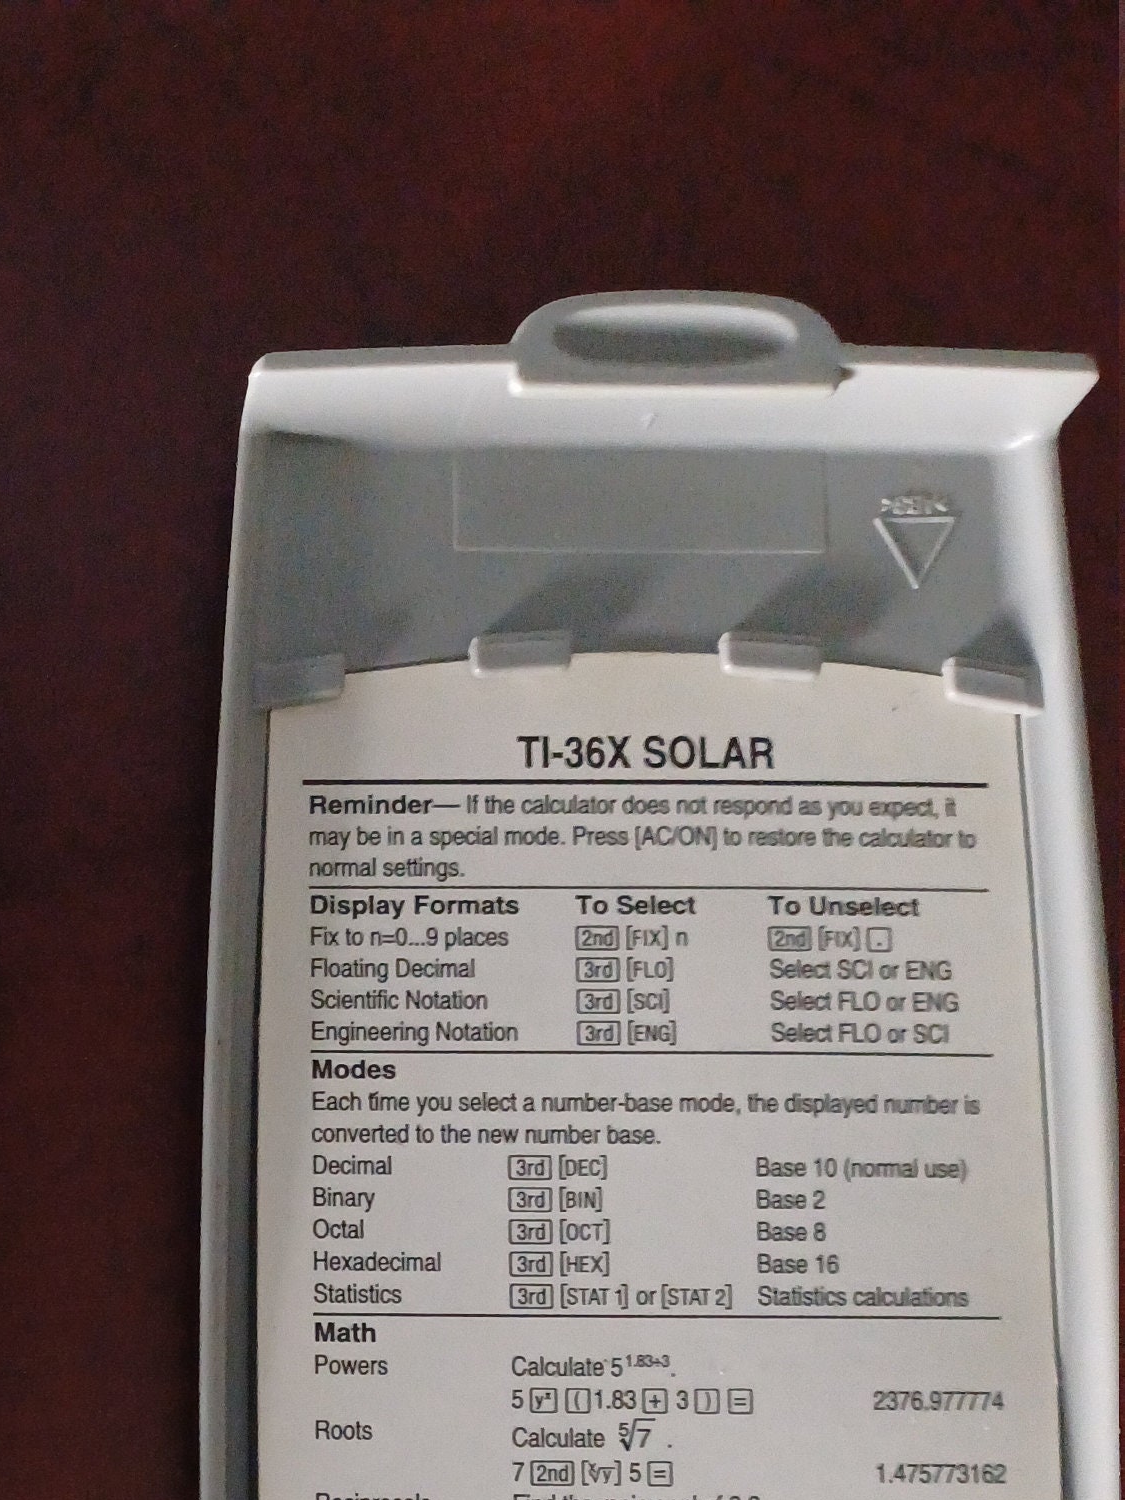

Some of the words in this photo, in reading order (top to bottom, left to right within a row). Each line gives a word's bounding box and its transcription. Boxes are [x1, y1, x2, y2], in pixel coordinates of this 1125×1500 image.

[517, 736, 631, 768] TI-36X
[644, 736, 773, 769] SOLAR
[309, 831, 351, 851] may
[356, 826, 381, 846] be
[387, 826, 404, 845] in
[411, 831, 423, 846] a
[430, 826, 498, 850] special
[504, 826, 565, 845] mode.
[573, 826, 629, 846] Press
[309, 858, 376, 877] normal
[383, 857, 464, 882] settings.
[310, 895, 405, 919] Display
[414, 895, 519, 914] Formats
[575, 895, 608, 915] To
[617, 895, 696, 915] Select
[768, 896, 801, 915] To
[809, 896, 919, 916] Unselect
[310, 926, 339, 946] Fix
[345, 928, 364, 946] to
[445, 927, 509, 951] places
[311, 957, 388, 983] Floating
[396, 958, 475, 978] Decimal
[311, 989, 399, 1009] Scientific
[406, 990, 488, 1010] Notation
[311, 1020, 429, 1047] Engineering
[436, 1021, 518, 1041] Notation
[312, 1059, 396, 1079] Modes
[312, 1091, 361, 1111] Each
[368, 1091, 409, 1111] time
[416, 1096, 452, 1117] you
[458, 1092, 517, 1112] select
[523, 1097, 535, 1112] a
[542, 1093, 673, 1112] number-base
[679, 1093, 741, 1115] mode,
[311, 1124, 409, 1143] converted
[415, 1125, 434, 1143] to
[440, 1124, 471, 1143] the
[478, 1129, 519, 1144] new
[525, 1124, 601, 1144] number
[607, 1125, 661, 1144] base.
[313, 1155, 392, 1175] Decimal
[313, 1187, 375, 1212] Binary
[313, 1218, 364, 1239] Octal
[313, 1251, 441, 1272] Hexadecimal
[314, 1283, 402, 1304] Statistics
[315, 1322, 376, 1342] Math
[315, 1354, 388, 1375] Powers
[315, 1420, 372, 1440] Roots
[512, 1427, 605, 1448] Calculate
